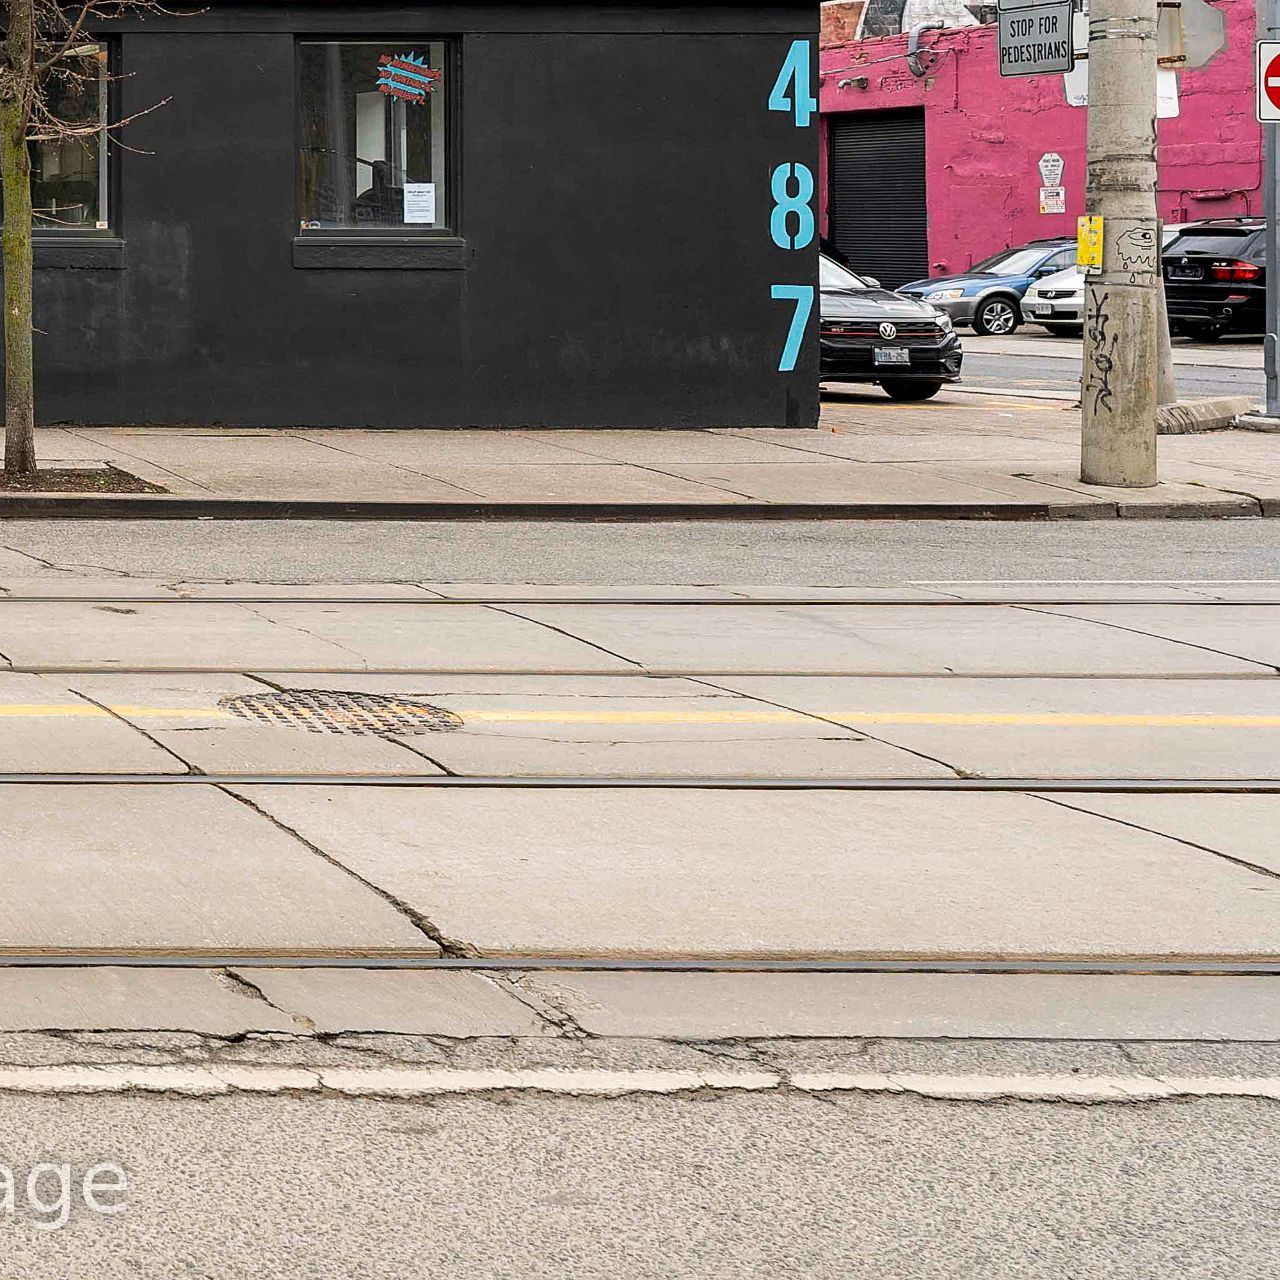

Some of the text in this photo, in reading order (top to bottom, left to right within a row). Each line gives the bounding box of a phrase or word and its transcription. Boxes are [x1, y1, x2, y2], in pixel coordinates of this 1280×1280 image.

[1010, 15, 1058, 38] STOP FOR
[1001, 40, 1067, 65] PEDESTRIANS
